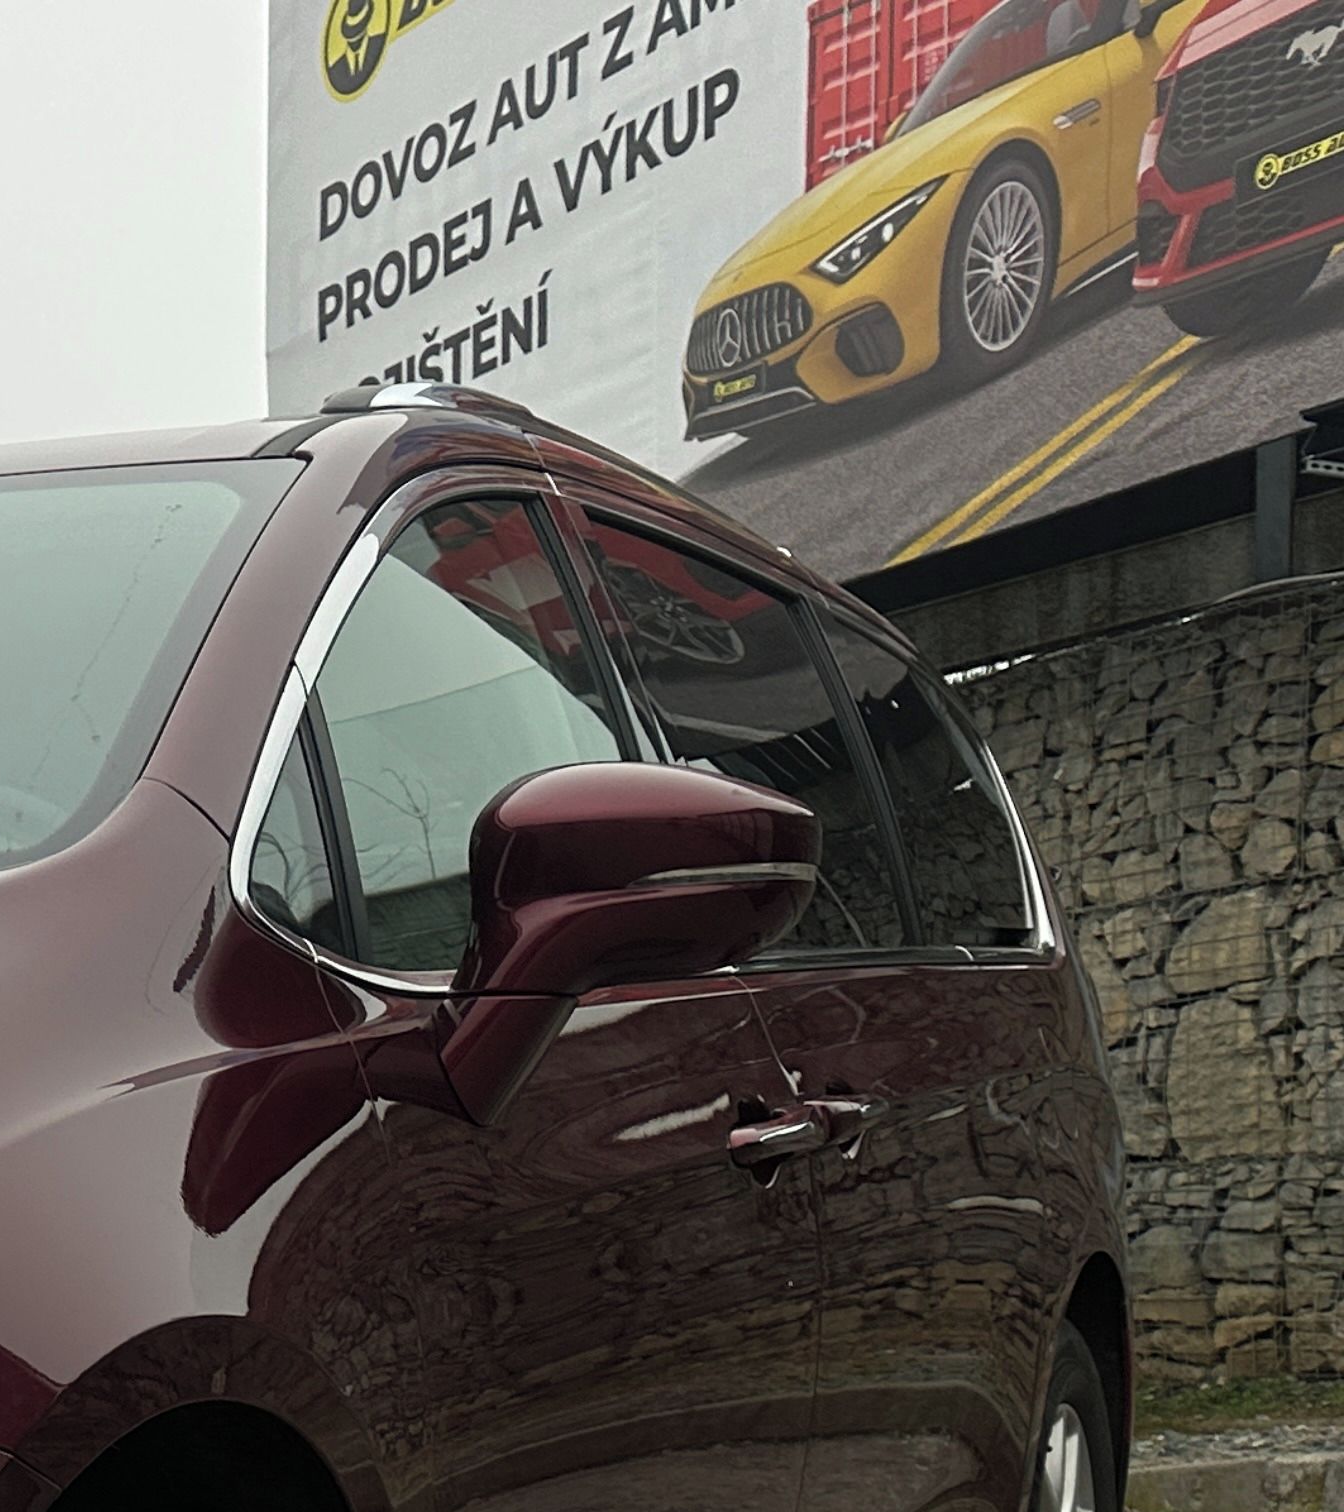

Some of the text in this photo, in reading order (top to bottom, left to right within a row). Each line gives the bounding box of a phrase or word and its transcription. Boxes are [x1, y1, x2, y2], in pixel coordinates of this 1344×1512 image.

[318, 68, 740, 342] PRODEJ A VÝKUP
[319, 99, 477, 241] DOVOZ
[487, 33, 589, 146] AUT
[601, 5, 634, 81] Z
[358, 268, 553, 386] ŠTĚNÍ
